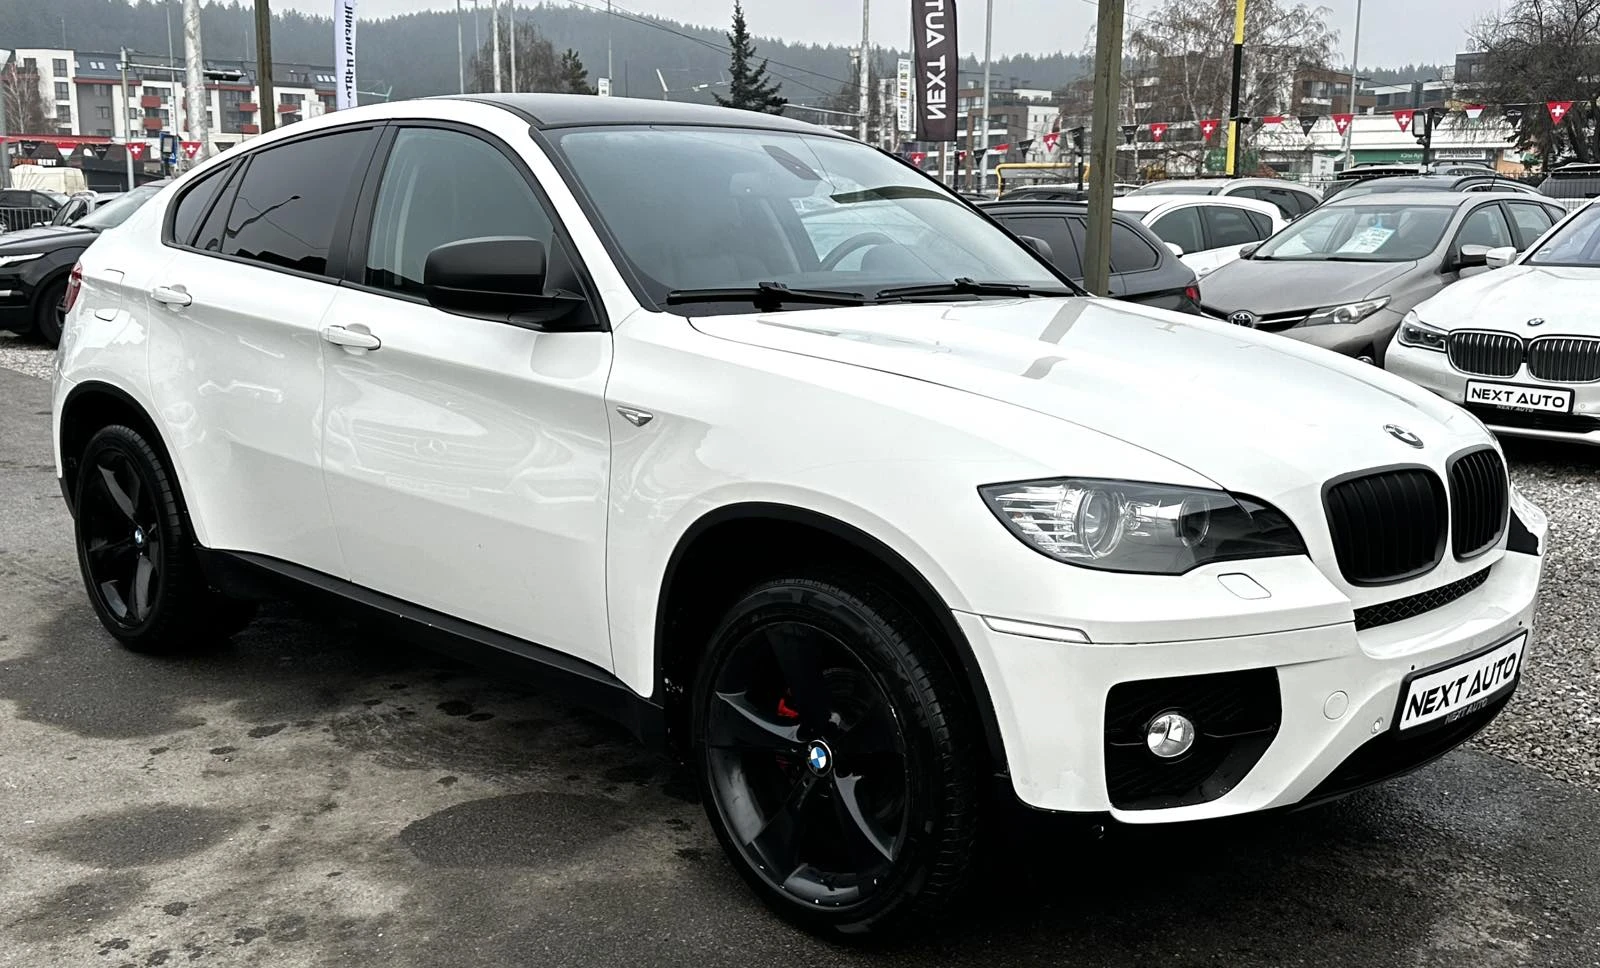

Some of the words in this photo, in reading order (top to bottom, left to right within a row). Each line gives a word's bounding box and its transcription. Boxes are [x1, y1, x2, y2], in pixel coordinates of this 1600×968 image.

[1471, 387, 1514, 402] NEXT
[1516, 392, 1565, 408] AUTO
[1405, 674, 1469, 721] NEXT
[1465, 652, 1517, 699] AUTO
[1444, 706, 1467, 725] NEXT
[1466, 697, 1488, 716] AUTO
